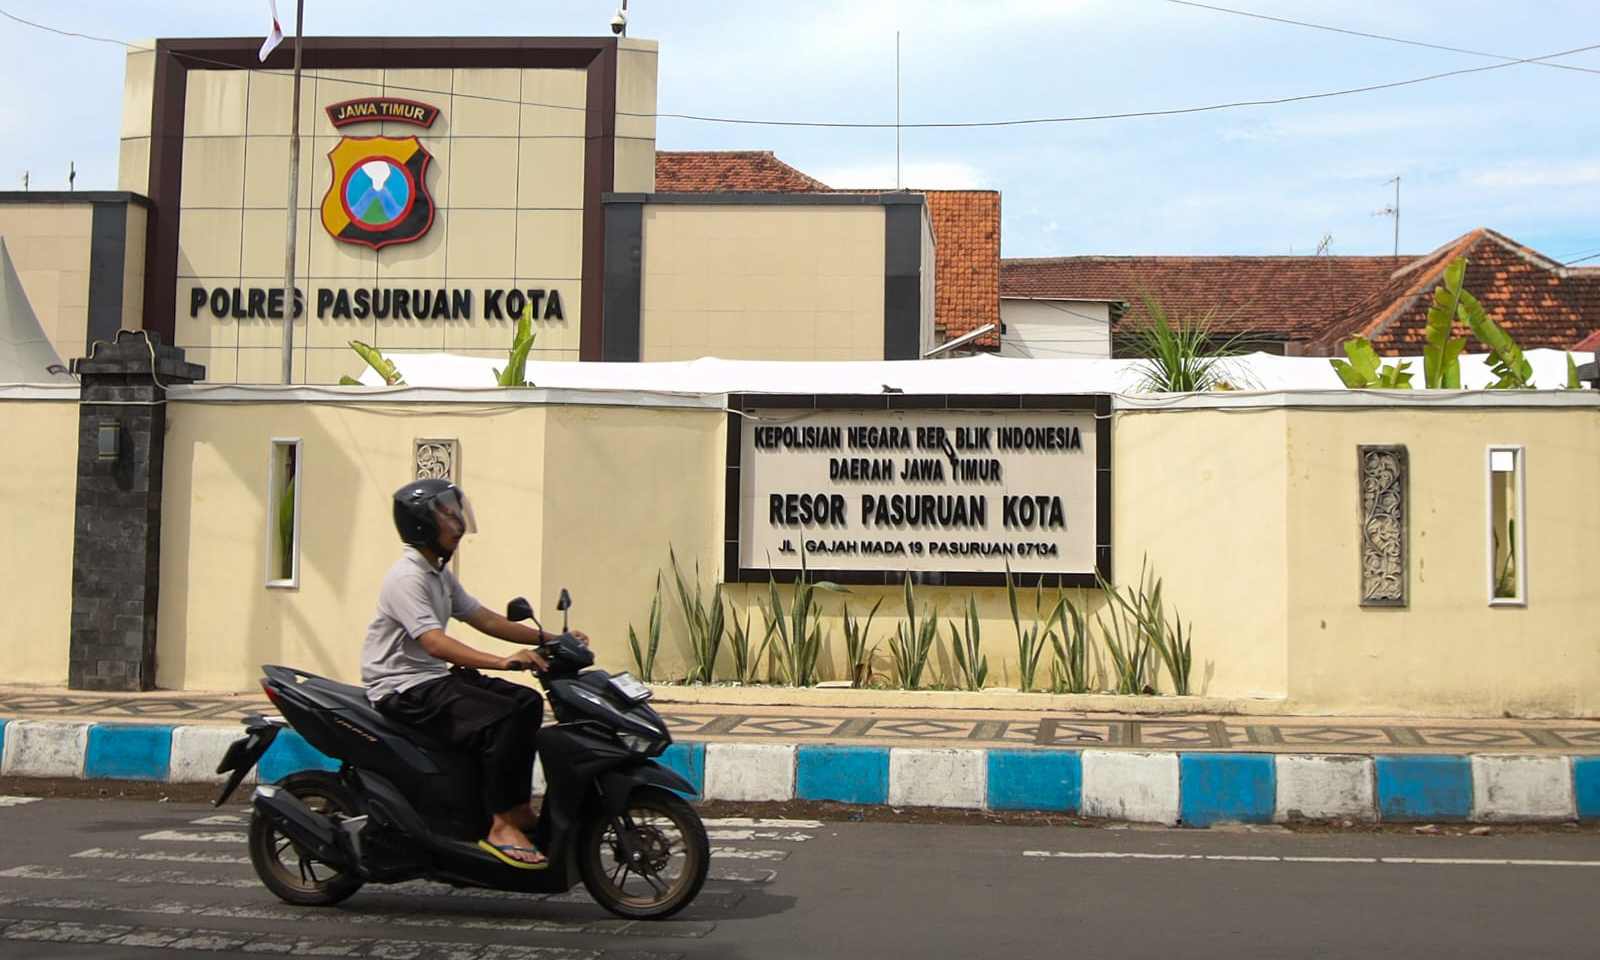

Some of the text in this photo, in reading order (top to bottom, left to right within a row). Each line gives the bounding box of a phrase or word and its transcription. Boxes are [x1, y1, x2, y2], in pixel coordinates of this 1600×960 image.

[338, 102, 425, 120] JAWA TIMUR
[190, 287, 564, 320] POLRES PASURUAN KOTA
[754, 426, 841, 449] KEPOLISIAN
[848, 427, 911, 449] NEGARA
[997, 427, 1081, 449] INDONESIA
[829, 458, 1001, 481] DAERAH JAWA TIMUR
[769, 493, 1065, 527] RESOR PASURUAN KOTA
[805, 540, 858, 554] GAJAH
[860, 541, 906, 554] MADA
[908, 541, 923, 554] 19
[928, 542, 1013, 555] PASURUAN
[1016, 543, 1057, 556] 67134
